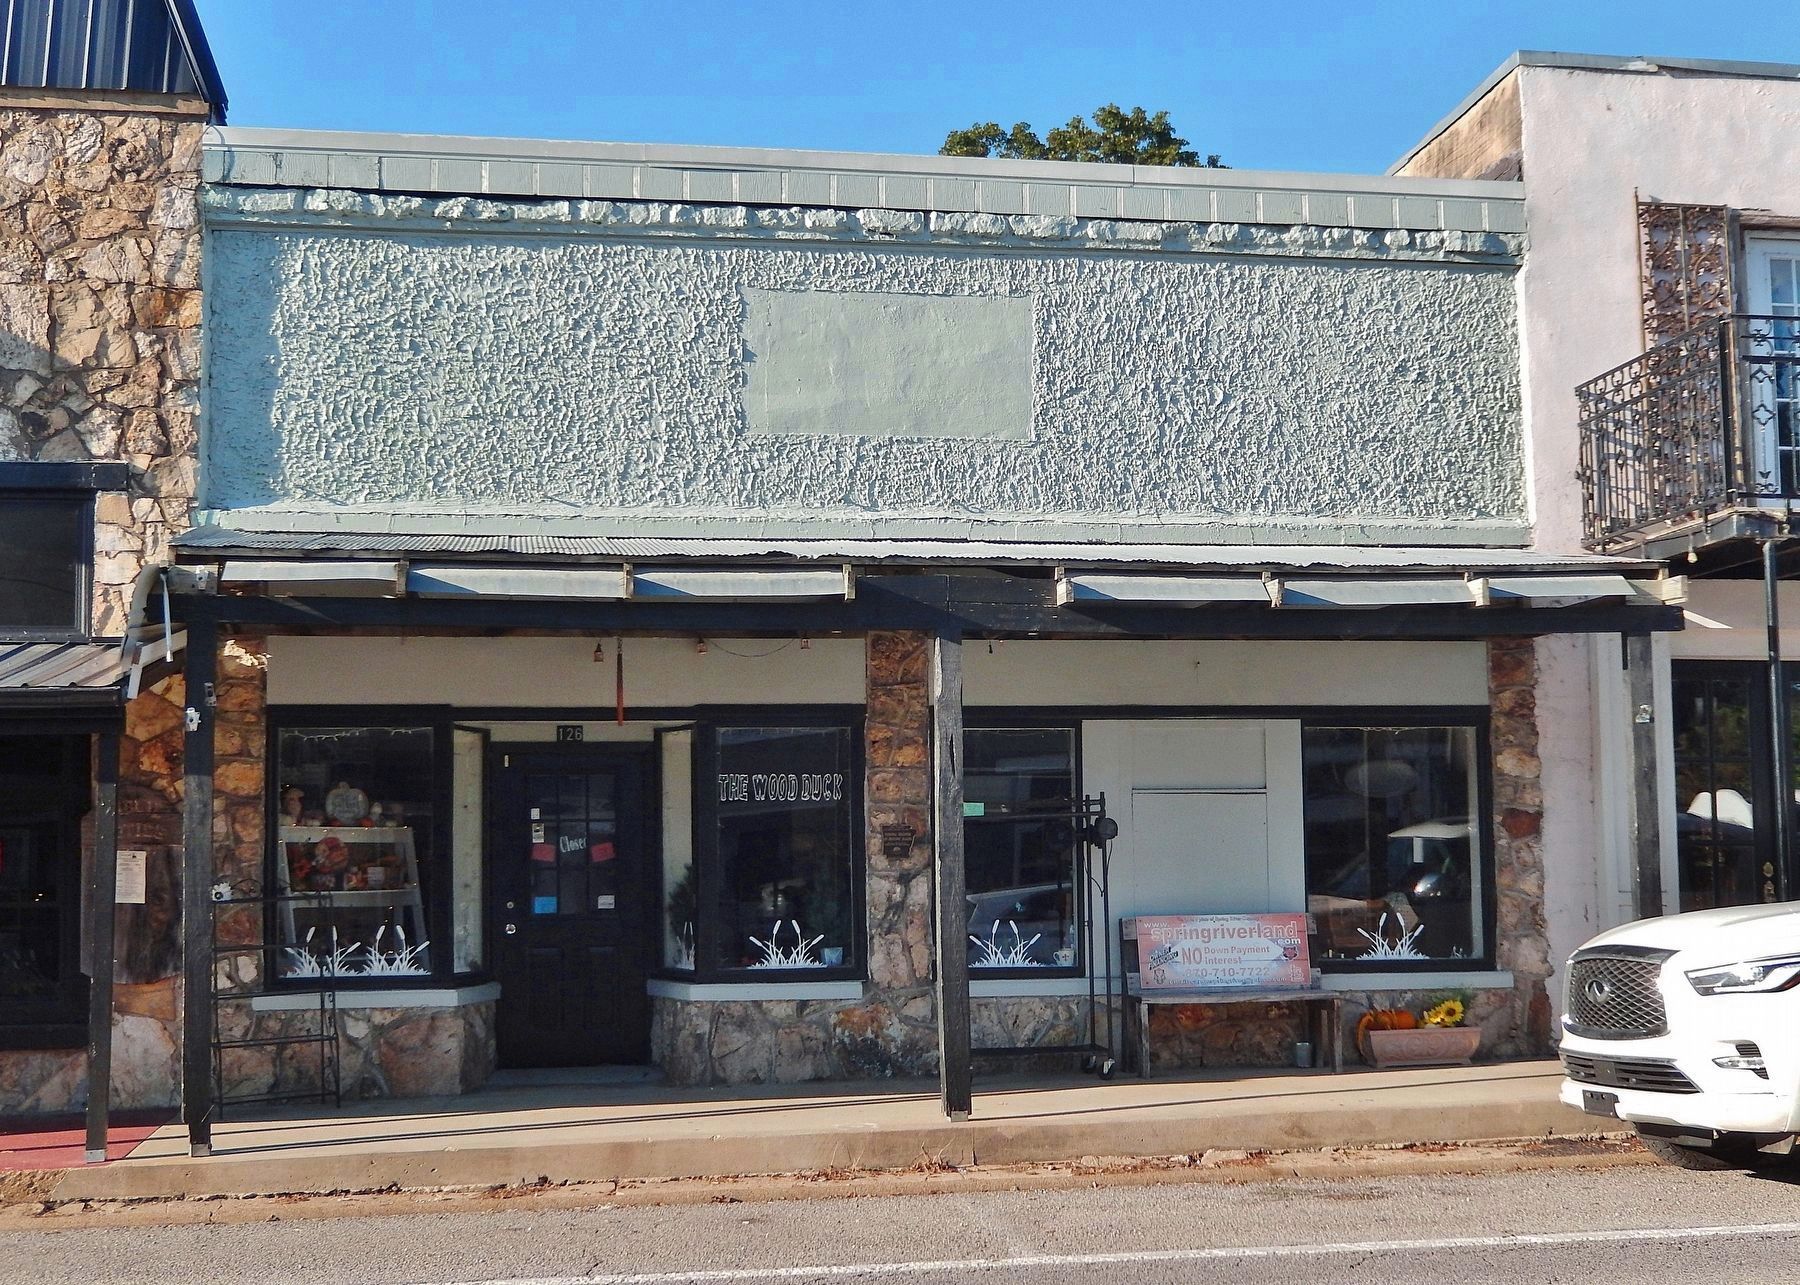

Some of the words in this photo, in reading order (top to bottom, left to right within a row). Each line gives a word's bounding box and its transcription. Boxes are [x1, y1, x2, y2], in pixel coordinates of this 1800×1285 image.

[558, 727, 583, 741] 126
[718, 773, 749, 801] THE
[752, 773, 799, 801] WOOD
[801, 773, 843, 801] DUCK
[1151, 921, 1298, 945] springriverland
[1182, 947, 1203, 965] NO
[1204, 946, 1229, 954] Down
[1231, 945, 1270, 956] Payment
